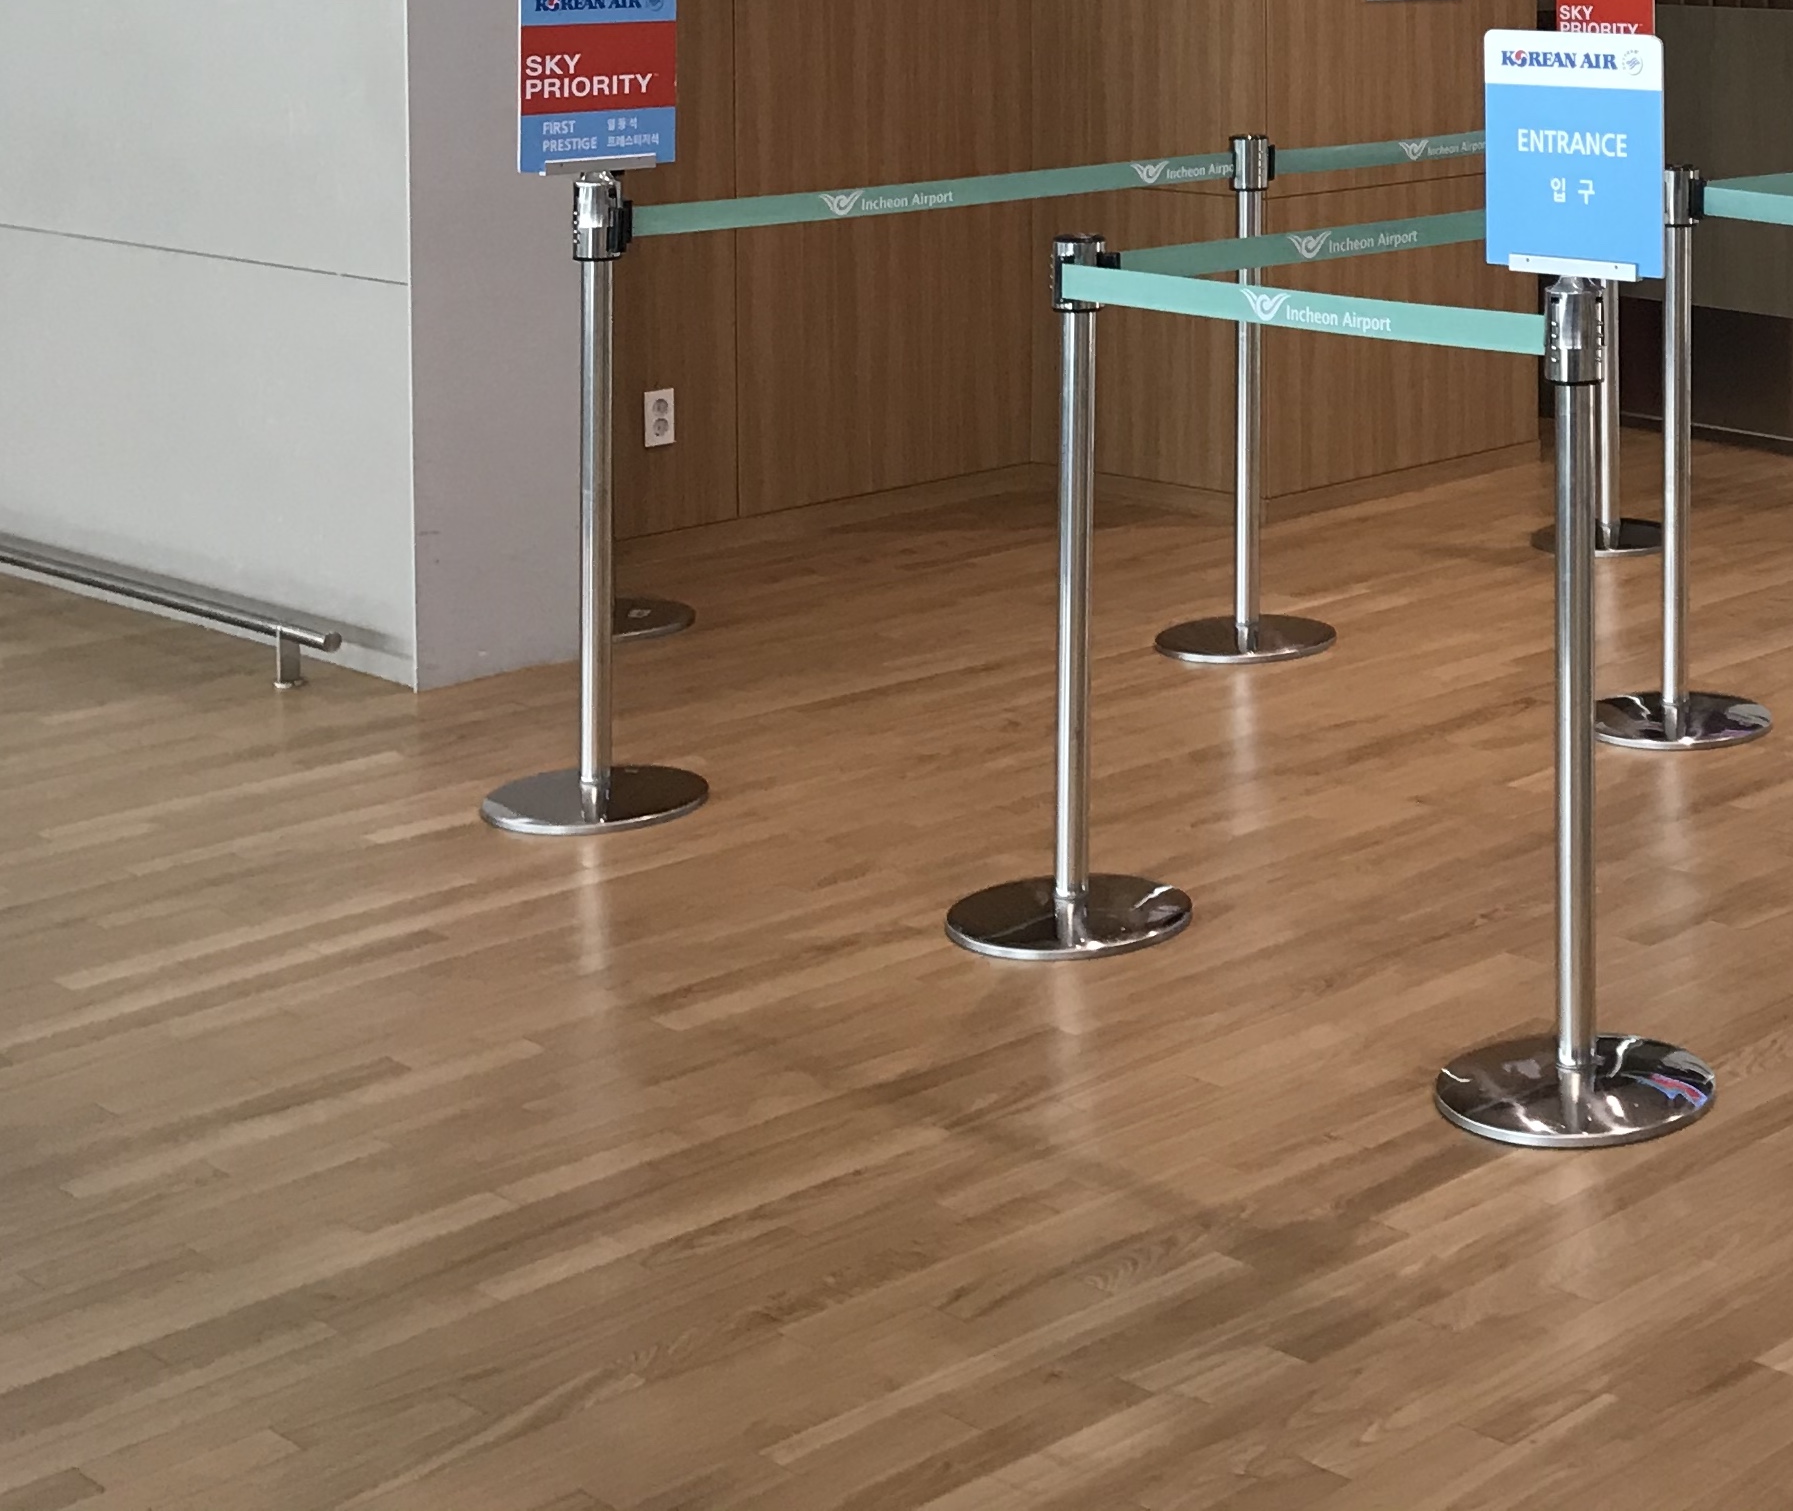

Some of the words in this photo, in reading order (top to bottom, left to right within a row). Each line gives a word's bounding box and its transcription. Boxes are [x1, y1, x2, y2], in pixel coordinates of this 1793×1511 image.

[1559, 5, 1593, 20] SKY
[1560, 22, 1639, 34] PRIORITY
[525, 53, 581, 77] SKY
[1501, 50, 1577, 69] KOREAN
[1580, 52, 1618, 70] AIR
[525, 73, 652, 100] PRIORITY
[543, 120, 576, 135] FIRST
[543, 137, 597, 152] PRESTIGE
[1461, 141, 1485, 153] Airpo
[1518, 129, 1628, 157] ENTRANCE
[1166, 166, 1206, 179] Incheon
[1208, 163, 1234, 176] Airpo
[861, 196, 908, 211] Incheon
[912, 191, 953, 206] Airport
[1329, 237, 1374, 253] Incheon
[1377, 231, 1418, 247] Airport
[1286, 305, 1339, 326] Incheon
[1342, 312, 1391, 333] Airport
